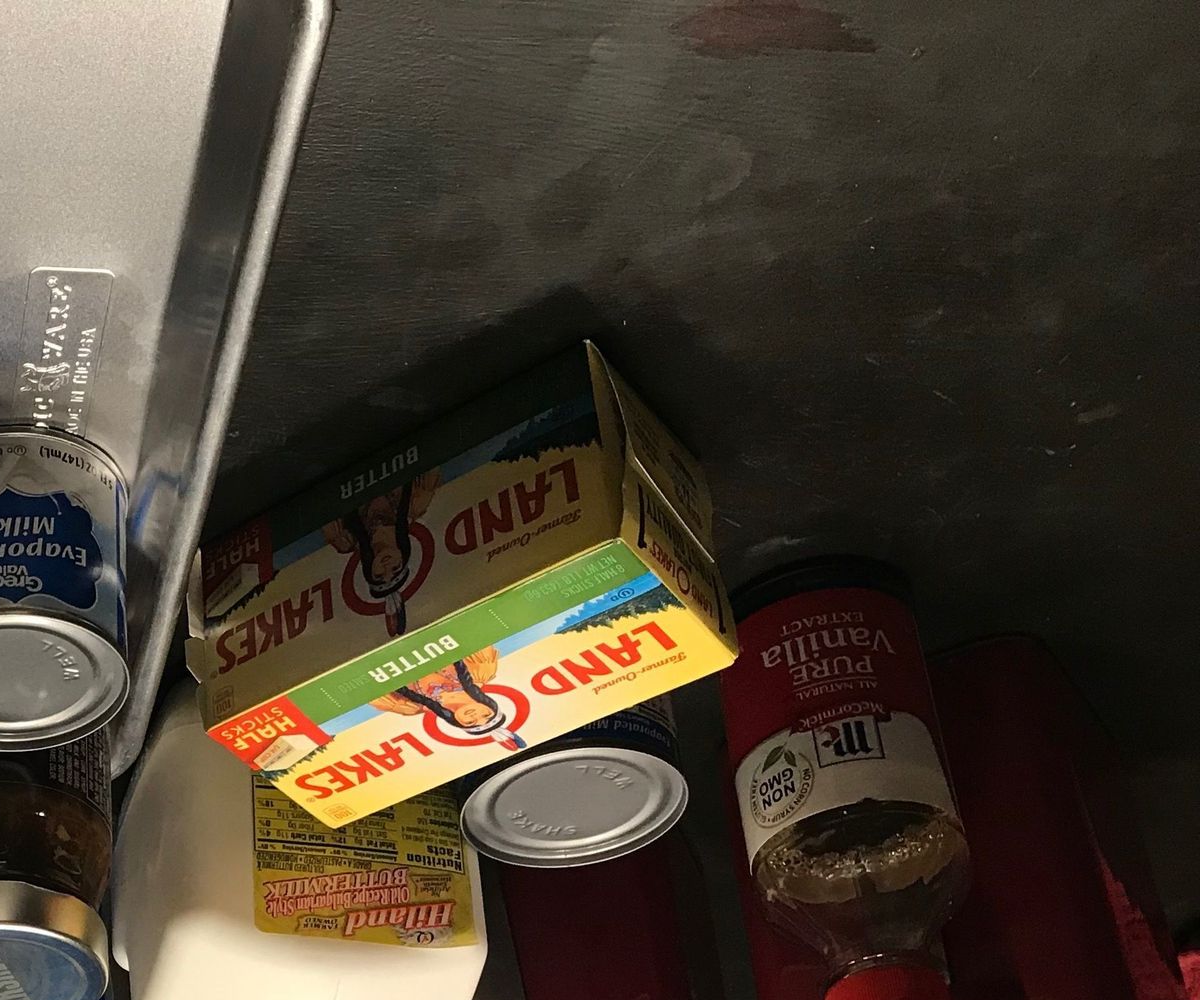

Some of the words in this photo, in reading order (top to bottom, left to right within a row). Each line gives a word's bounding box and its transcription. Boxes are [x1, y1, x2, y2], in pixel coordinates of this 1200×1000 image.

[39, 446, 85, 470] (147mL)
[338, 445, 418, 500] BUTTER
[444, 458, 580, 555] LAND
[486, 508, 582, 563] Farmer-Owned
[205, 536, 260, 579] HALF
[600, 555, 617, 571] NET
[560, 576, 591, 597] STICKS
[594, 567, 617, 586] HALF
[215, 578, 334, 675] LAKES
[779, 611, 864, 637] EXTRACT
[41, 639, 80, 681] WELL
[367, 634, 460, 683] BUTTER
[530, 621, 678, 695] LAND
[760, 627, 897, 668] Vanilla
[591, 651, 687, 695] Farmer-Owned
[788, 655, 874, 685] PURE
[795, 682, 854, 700] NATURAL
[859, 679, 878, 689] ALL
[219, 706, 284, 741] STICKS
[581, 719, 609, 731] Mil
[800, 700, 885, 728] McCormick
[231, 715, 296, 751] HALF
[613, 719, 671, 748] Evaporated
[294, 732, 435, 800] LAKES
[575, 764, 633, 791] WELL
[803, 768, 810, 781] NO
[759, 768, 794, 796] GMO
[762, 781, 796, 810] NON
[796, 782, 809, 805] CORN
[508, 810, 576, 836] SHAKE
[771, 803, 794, 823] SYRUP
[406, 853, 462, 871] Nutrition
[426, 845, 461, 860] Facts
[263, 867, 409, 900] BUTTERMILK
[352, 887, 388, 906] Recipe
[389, 886, 409, 904] Old
[265, 897, 294, 918] Style
[295, 891, 351, 913] Bulgarian
[302, 922, 338, 930] FARMER
[343, 901, 454, 937] Hiland
